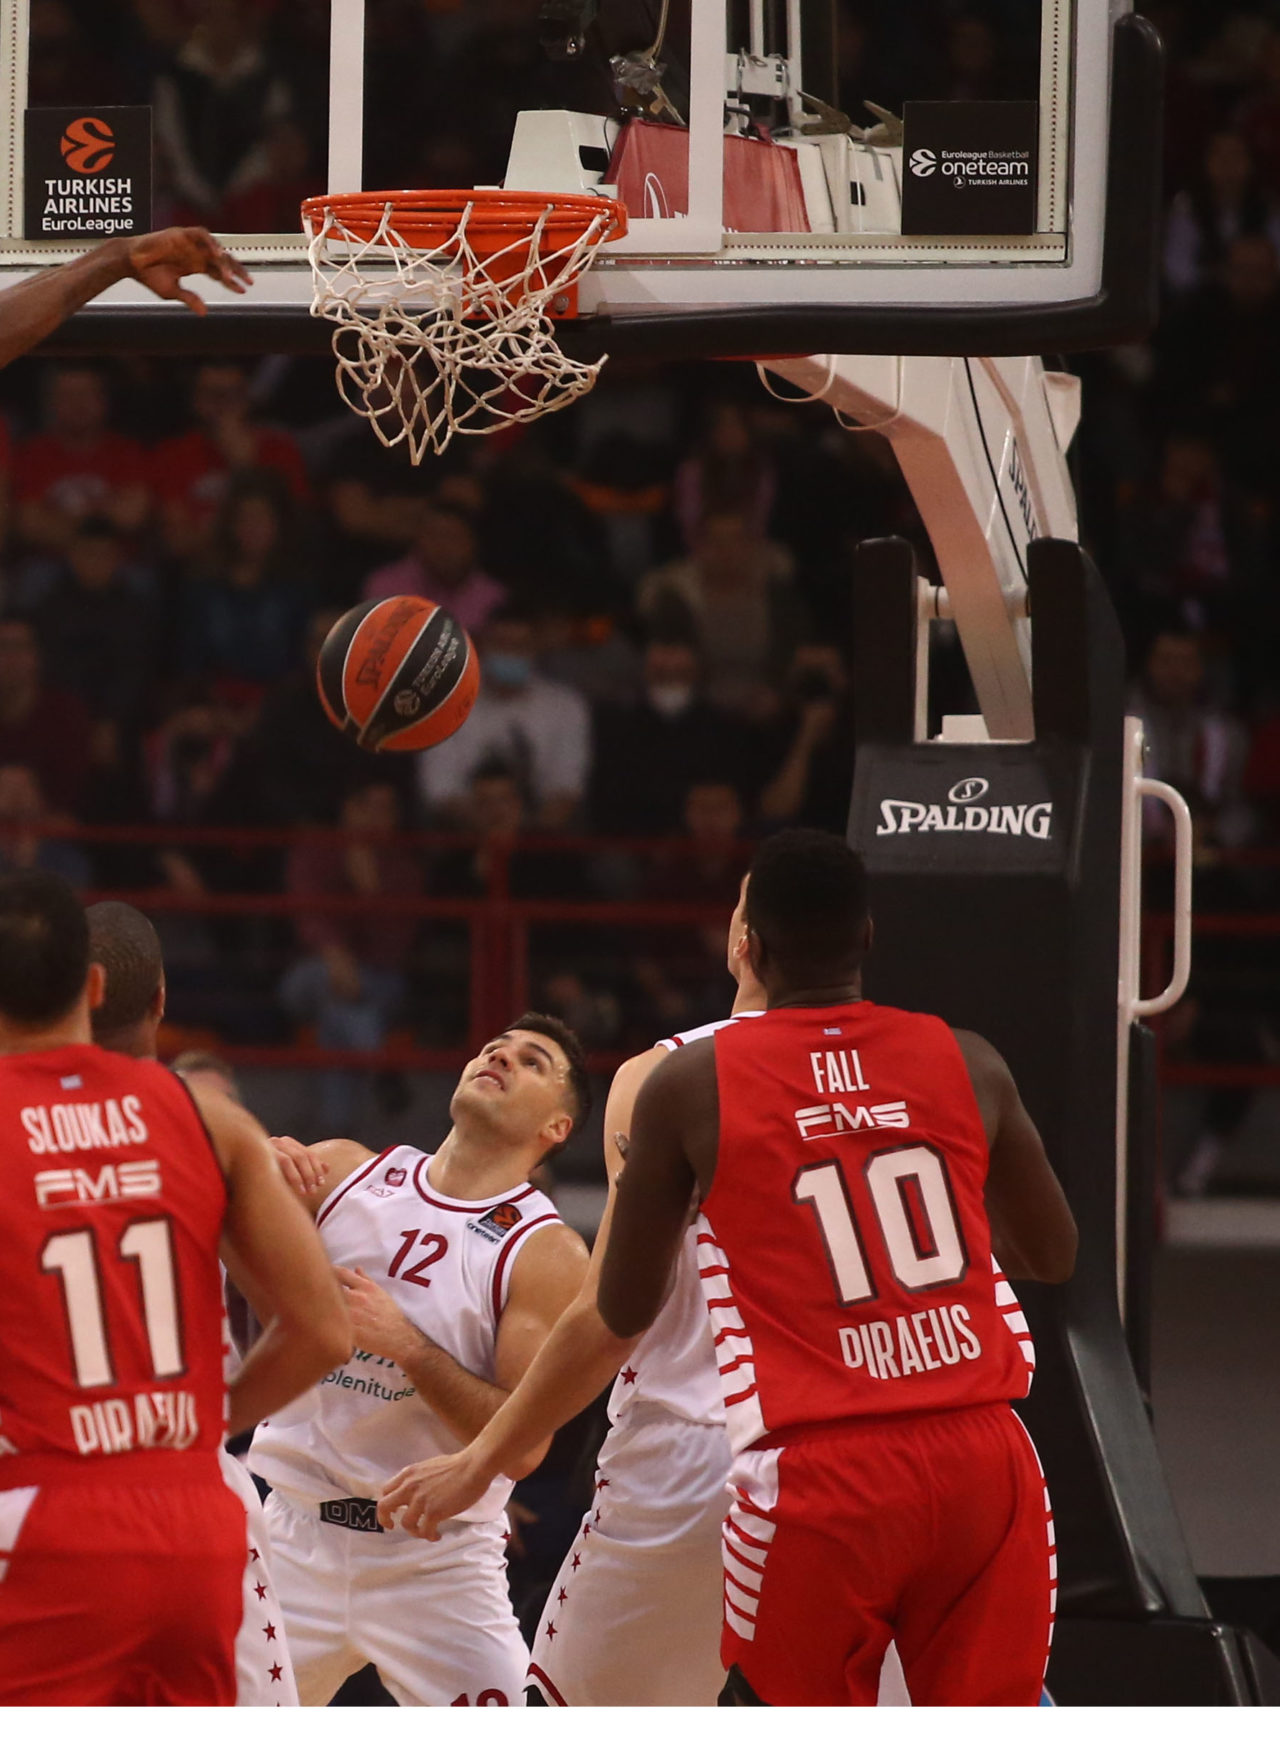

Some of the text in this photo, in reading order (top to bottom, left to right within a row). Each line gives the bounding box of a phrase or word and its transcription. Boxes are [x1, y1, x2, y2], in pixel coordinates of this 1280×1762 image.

[941, 150, 1029, 160] Euroleague Basketball
[941, 159, 1029, 176] oneteam
[44, 197, 132, 214] AIRLINES
[45, 179, 131, 196] TURKISH
[42, 217, 134, 233] EuroLeague
[876, 799, 1053, 839] SPALDING
[810, 1049, 870, 1094] FALL
[20, 1094, 148, 1155] SLOUKAS
[794, 1101, 910, 1140] FMS
[34, 1160, 162, 1209] FMS
[791, 1141, 969, 1308] 10
[387, 1228, 449, 1289] 12
[40, 1214, 188, 1389] 11
[838, 1303, 982, 1380] PIRAEUS
